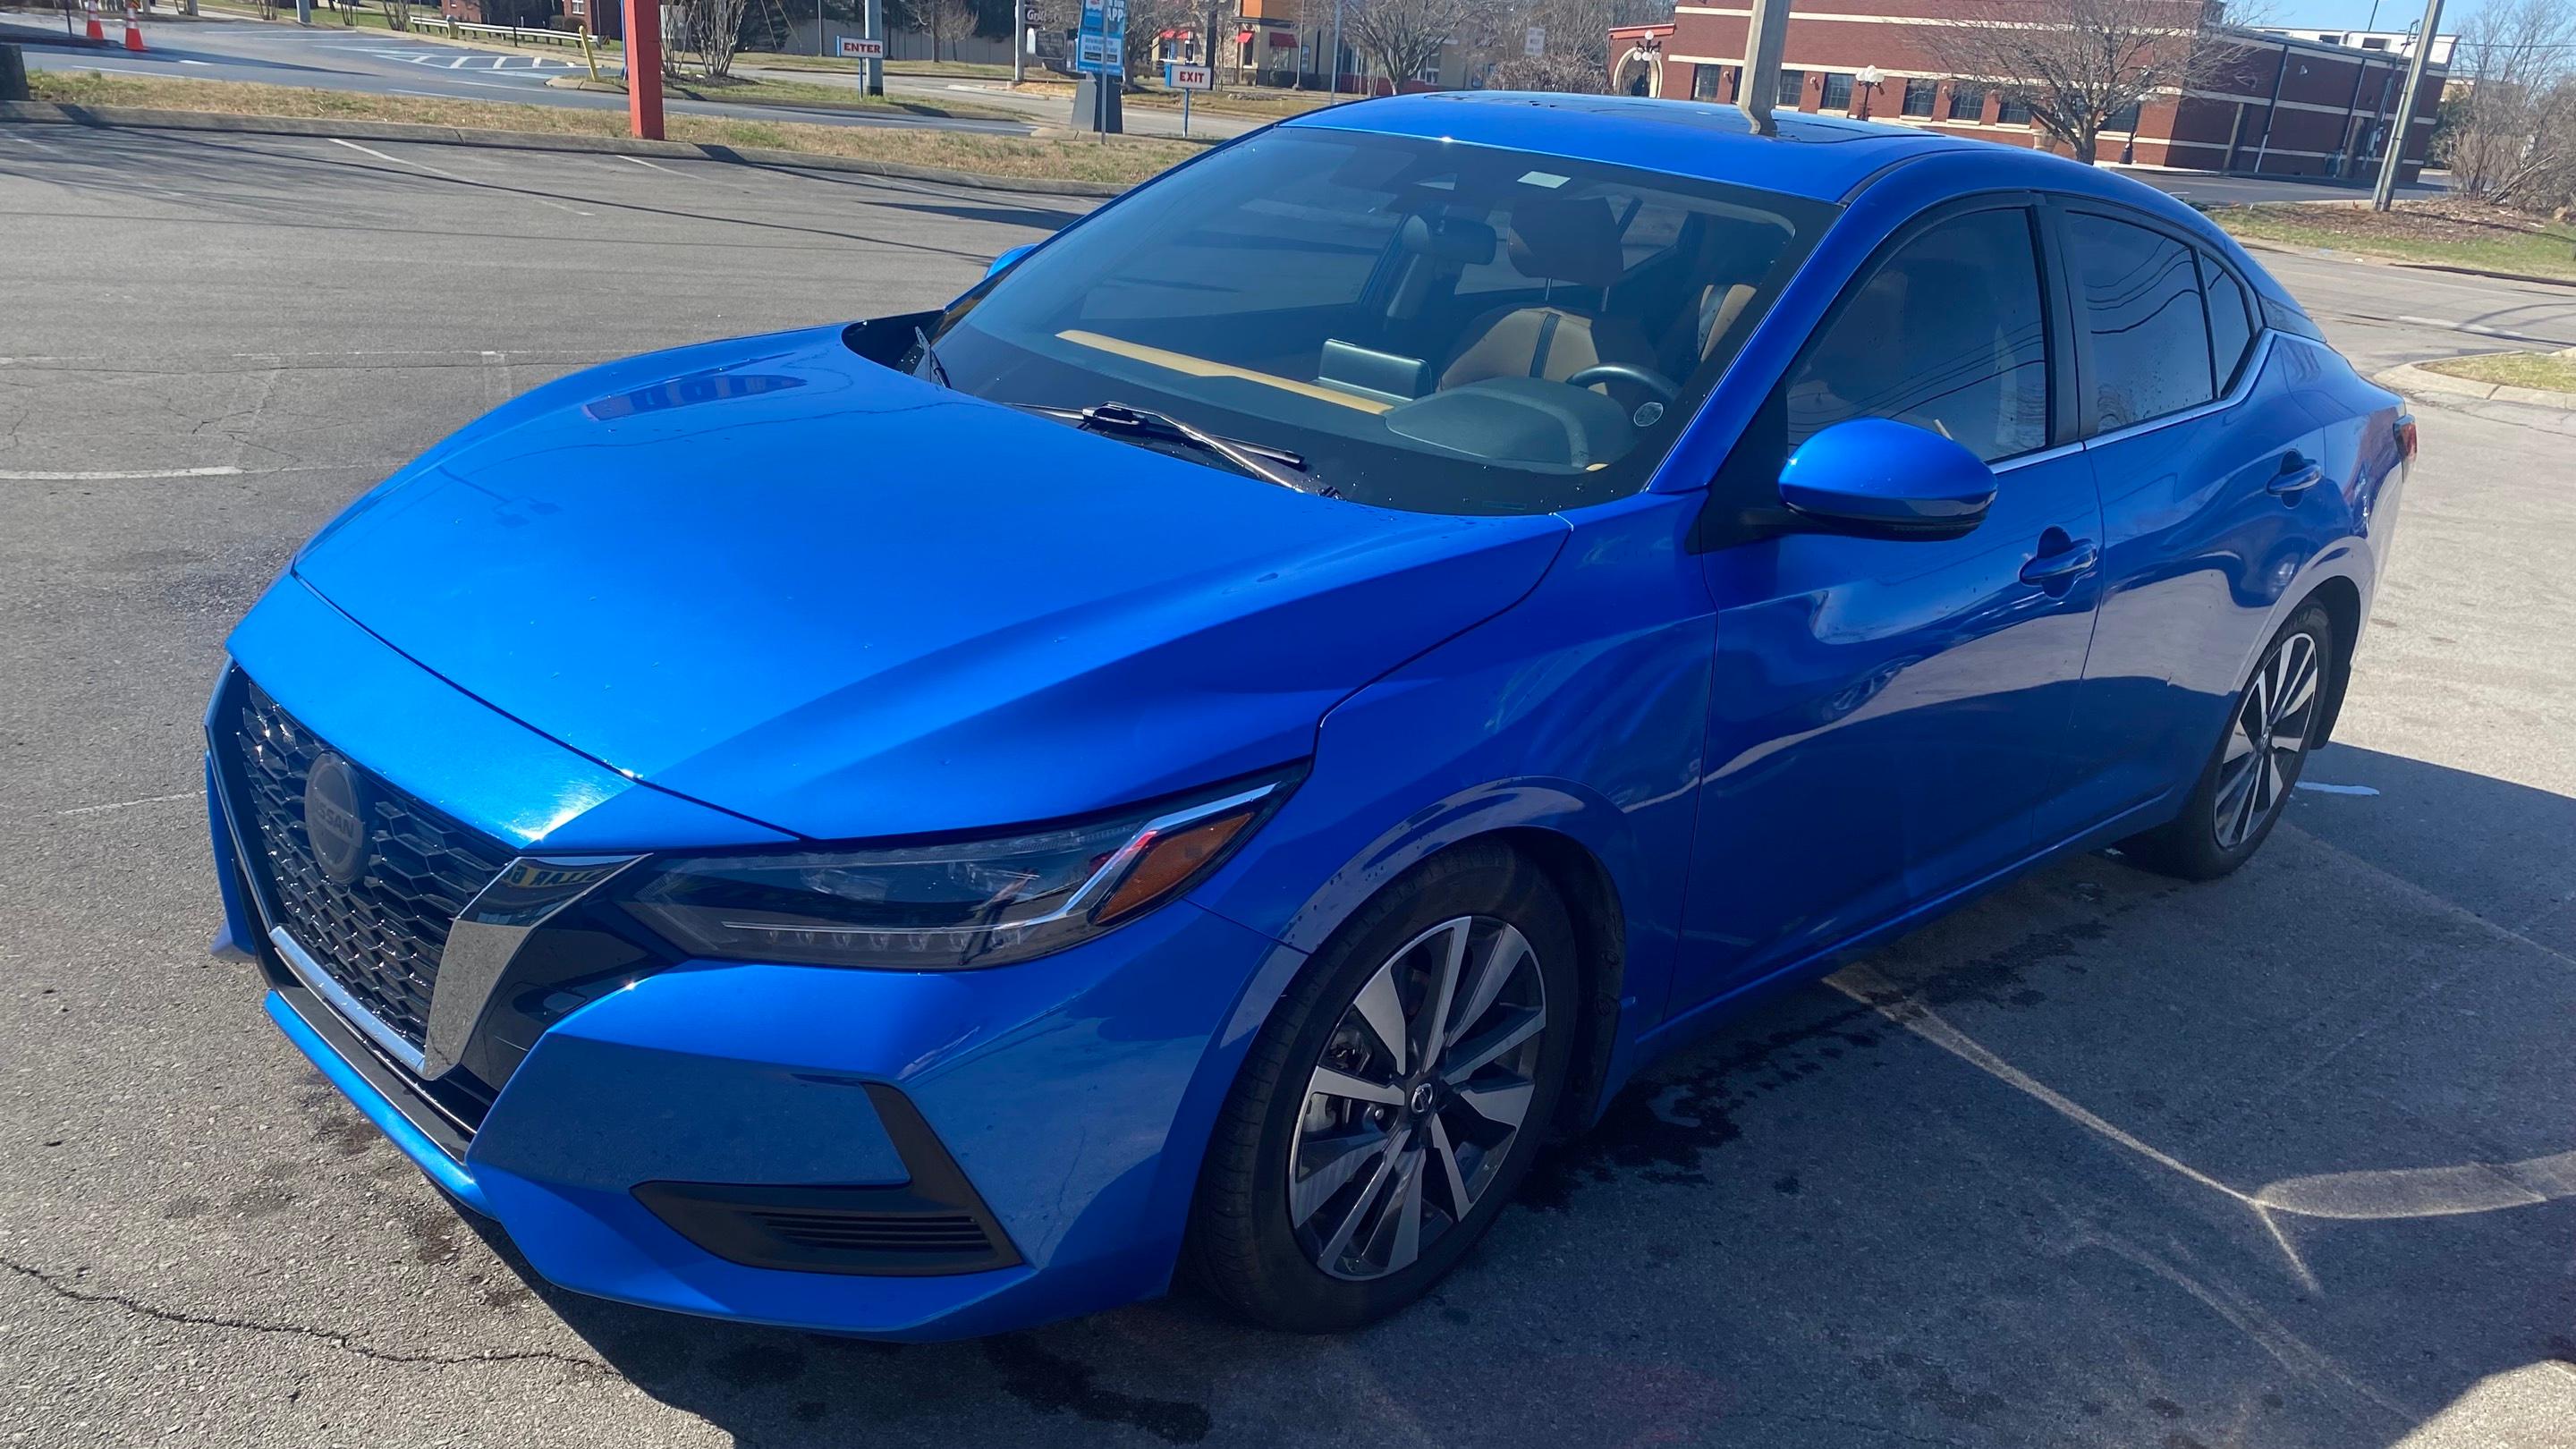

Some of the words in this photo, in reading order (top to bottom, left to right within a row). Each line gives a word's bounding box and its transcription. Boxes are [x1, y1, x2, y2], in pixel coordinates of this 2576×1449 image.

[1106, 7, 1123, 22] APP
[843, 42, 881, 54] ENTER
[1179, 71, 1205, 83] EXIT
[314, 798, 355, 838] ISSAN
